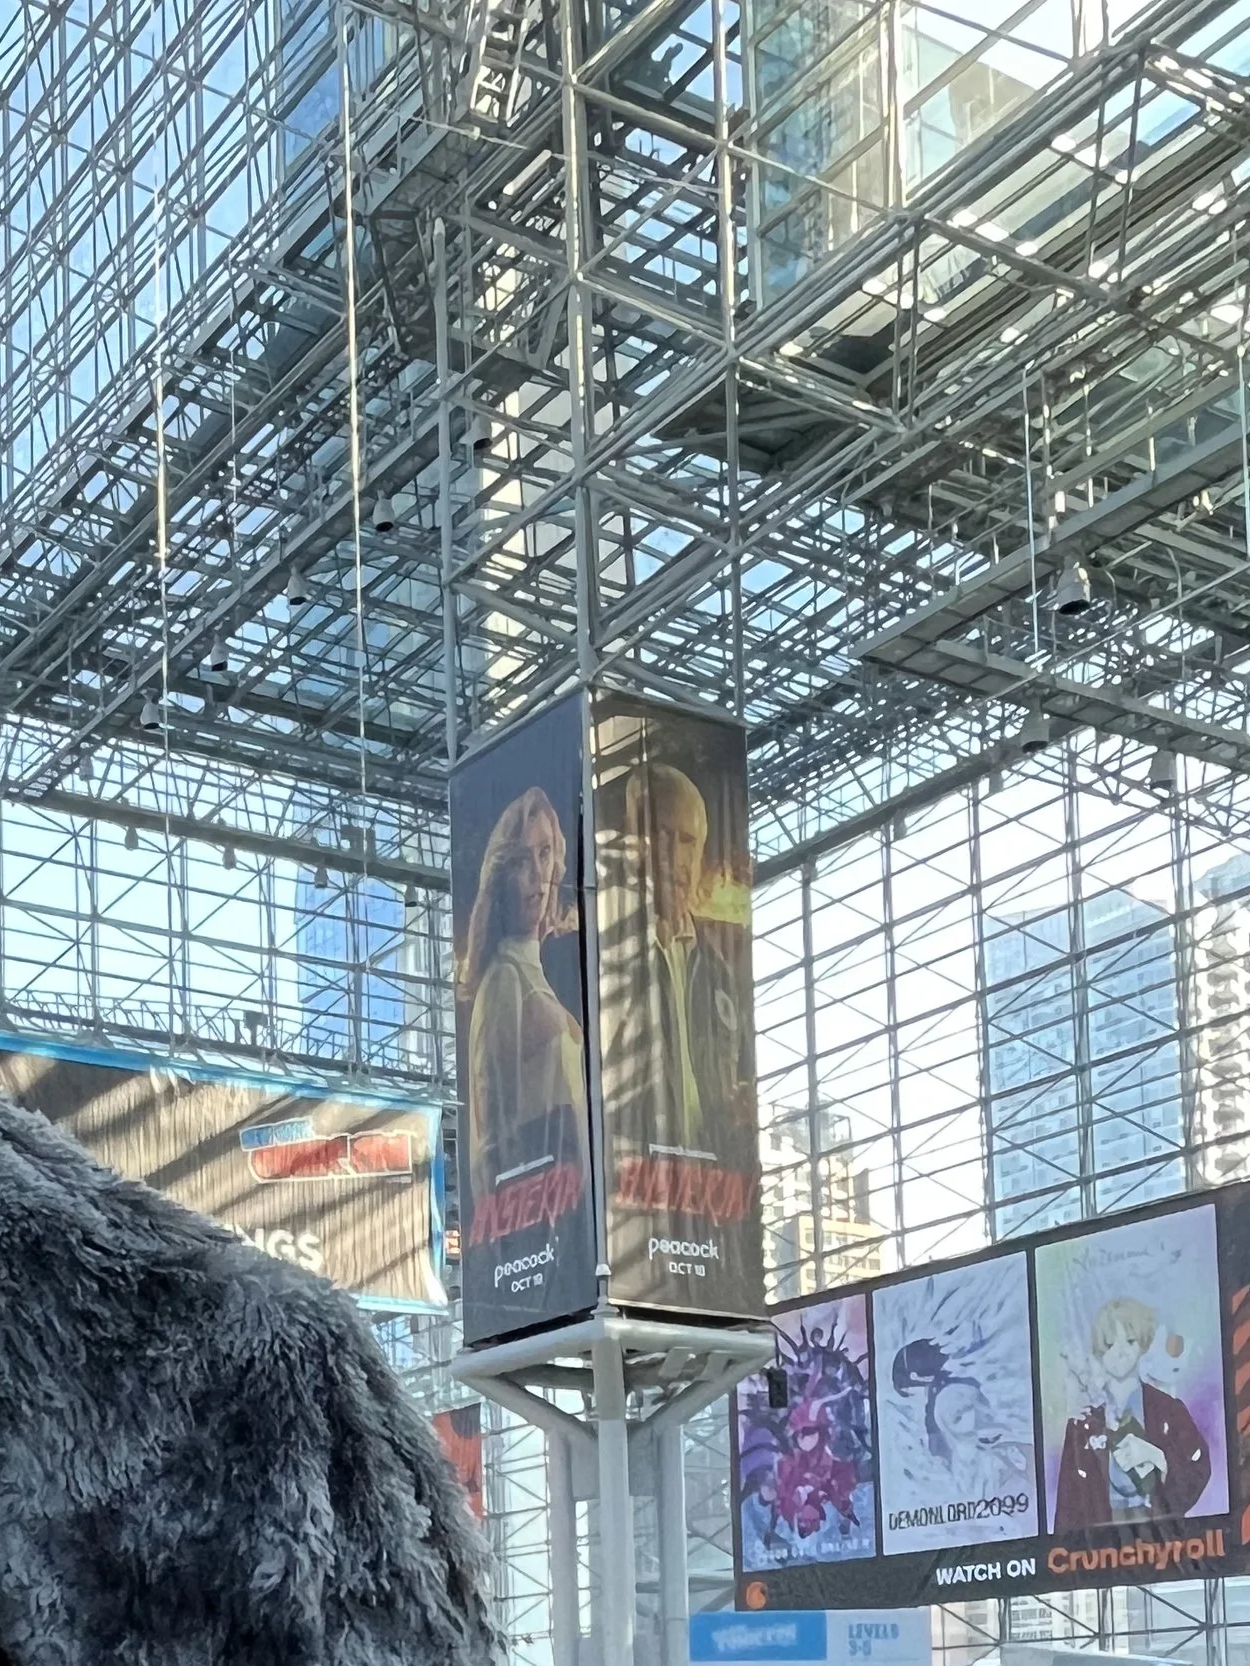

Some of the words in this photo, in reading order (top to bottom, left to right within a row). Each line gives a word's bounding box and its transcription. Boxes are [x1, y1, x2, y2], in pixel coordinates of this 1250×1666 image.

[648, 1238, 719, 1260] peacock
[669, 1262, 692, 1275] OCT
[936, 1560, 1002, 1586] WATCH
[1007, 1558, 1036, 1578] ON
[1047, 1528, 1227, 1574] Crunchyroll
